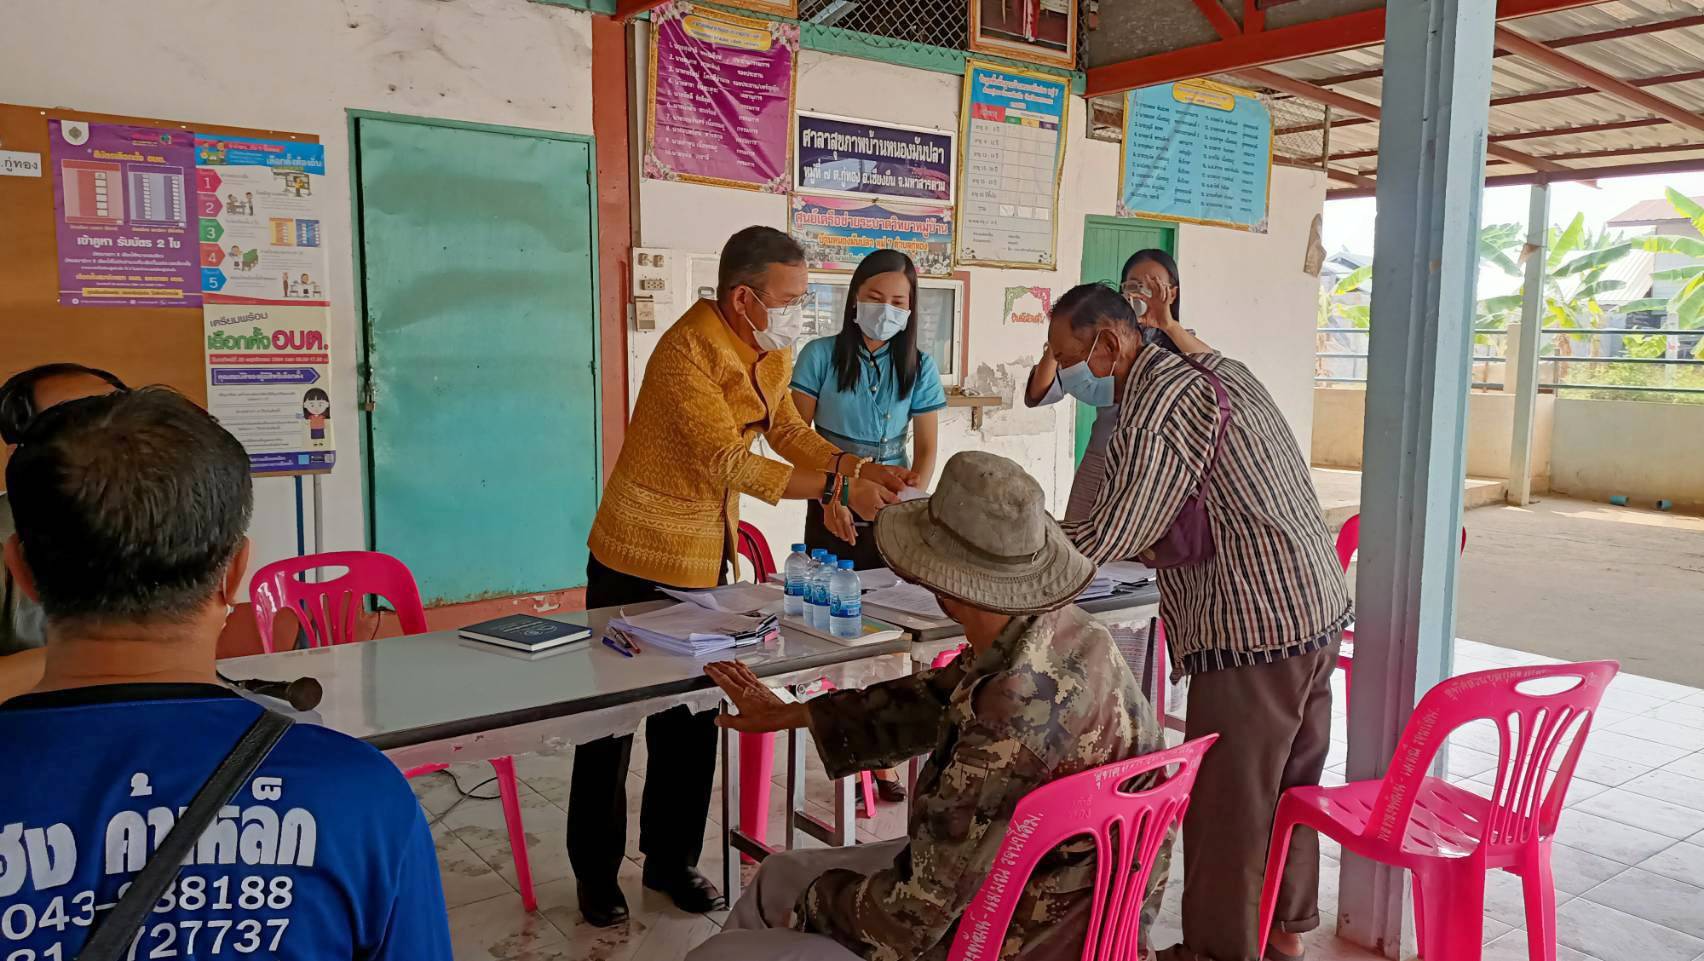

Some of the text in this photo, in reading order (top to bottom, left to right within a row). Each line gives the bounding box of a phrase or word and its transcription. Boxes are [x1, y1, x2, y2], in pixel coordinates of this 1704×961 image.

[203, 177, 211, 189] 1
[206, 202, 216, 214] 2
[206, 227, 216, 239] 3
[117, 236, 152, 248] รับบัตร
[157, 239, 165, 248] 2
[168, 237, 181, 248] ใบ
[208, 252, 216, 263] 4
[208, 277, 218, 289] 5
[210, 312, 268, 327] เตรียมพร้อม
[1, 875, 293, 941] 043-8188
